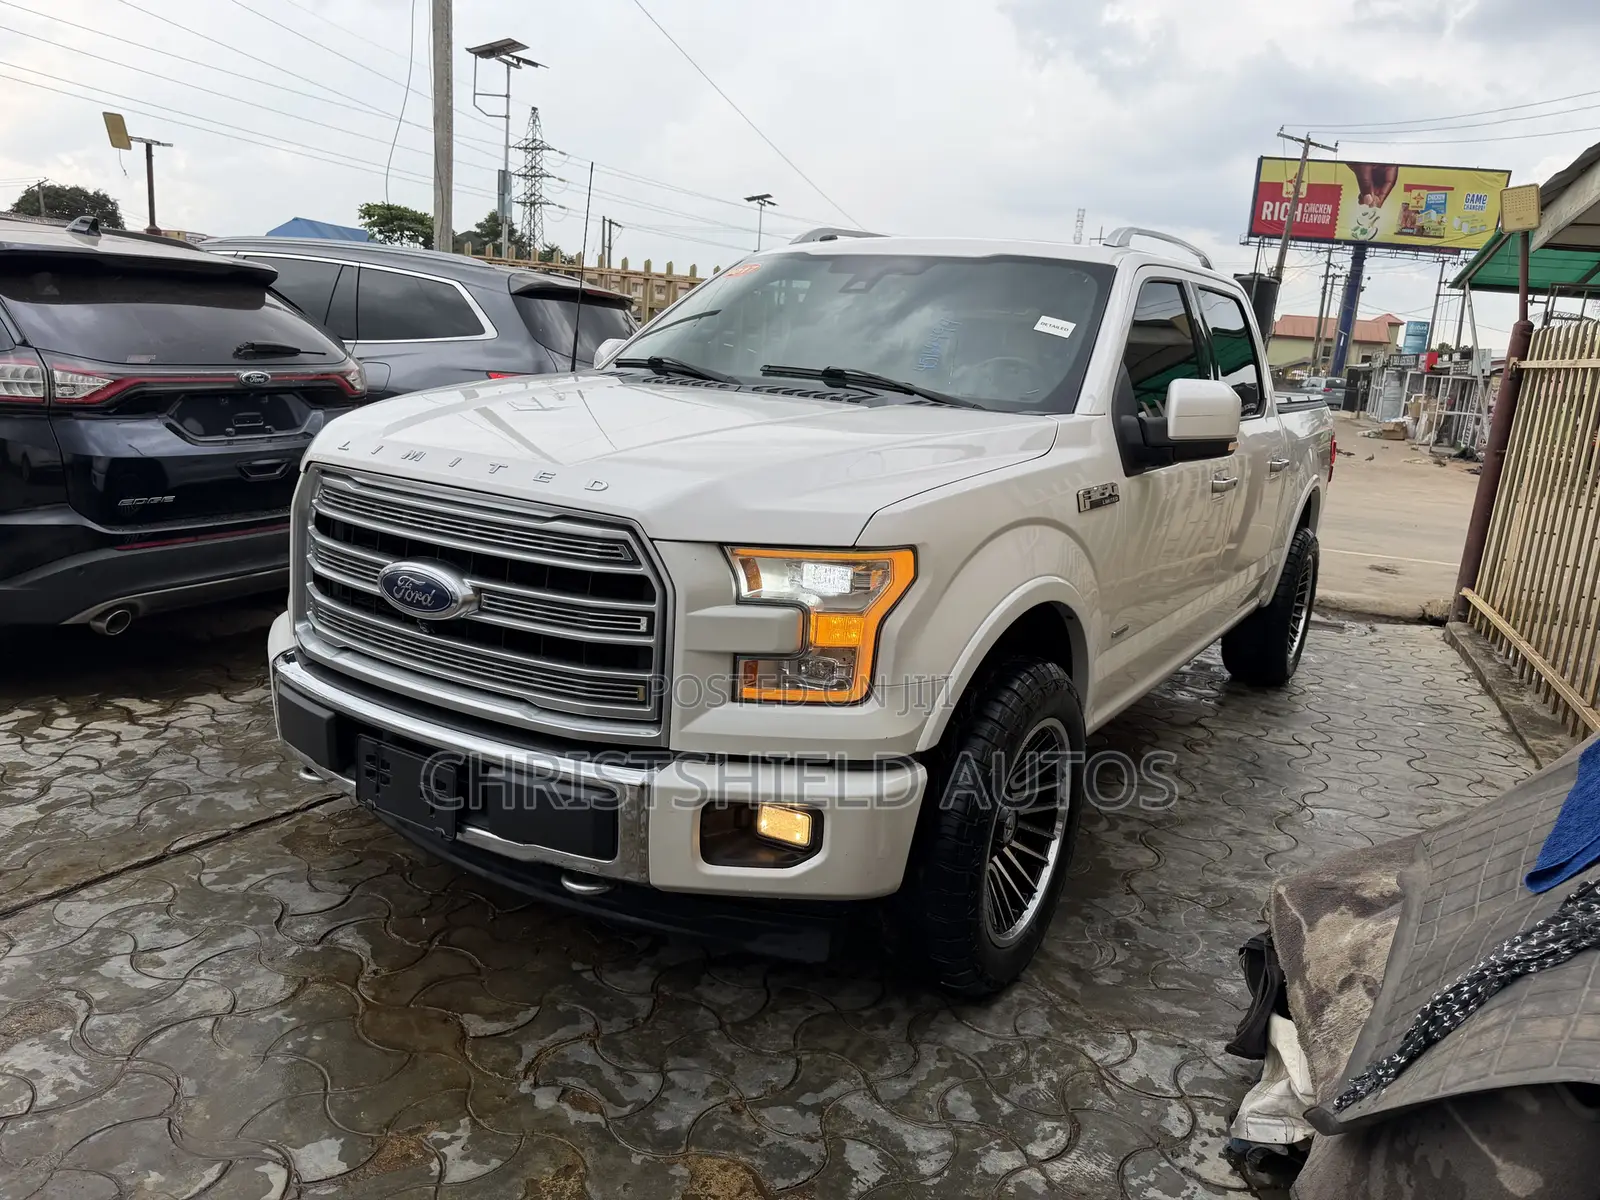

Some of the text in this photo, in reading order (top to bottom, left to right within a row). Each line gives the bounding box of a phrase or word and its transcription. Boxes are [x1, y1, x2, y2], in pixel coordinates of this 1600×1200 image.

[1303, 203, 1332, 214] CHICKEN
[1302, 213, 1331, 225] FLAVOUR
[1040, 321, 1069, 332] DETAILED
[250, 373, 265, 383] Ford
[337, 439, 610, 493] LIMITED
[118, 495, 176, 506] EDGE
[392, 574, 435, 608] Ford
